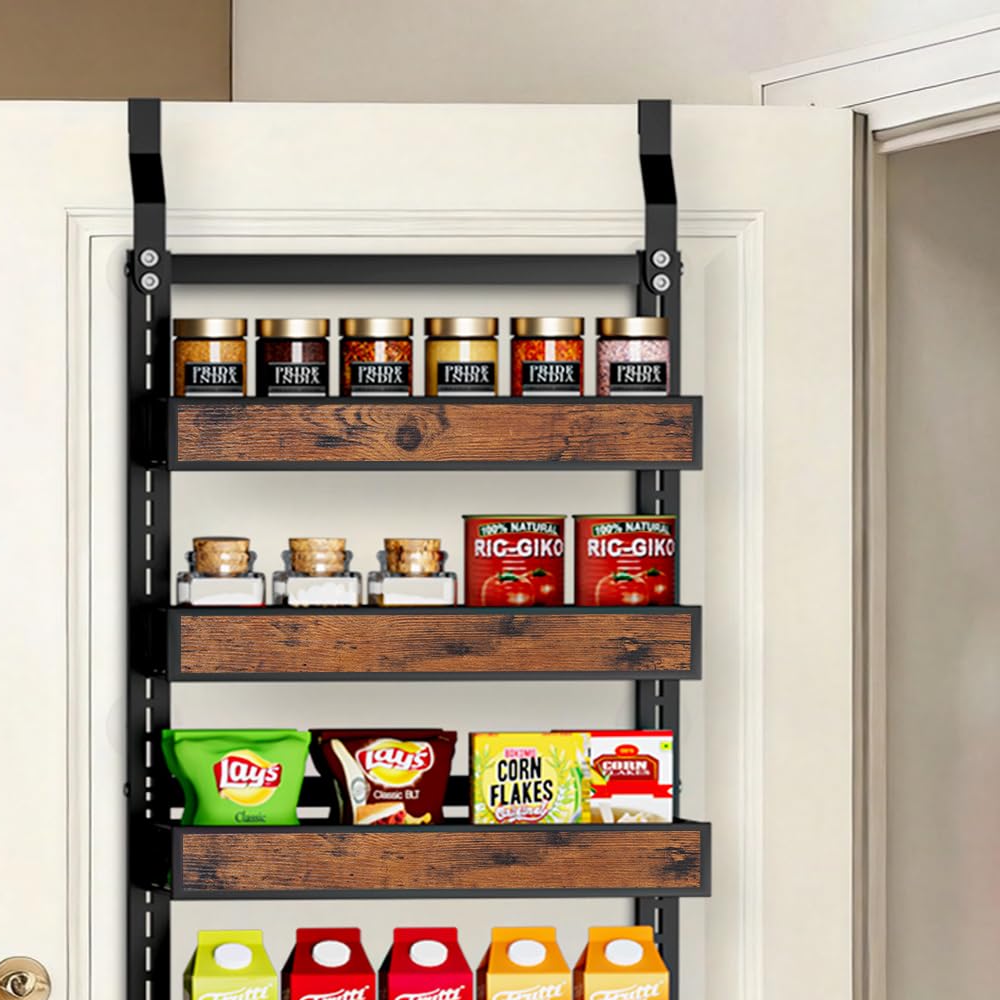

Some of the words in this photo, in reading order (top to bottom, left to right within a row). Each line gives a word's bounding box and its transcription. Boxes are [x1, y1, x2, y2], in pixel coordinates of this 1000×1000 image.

[482, 524, 508, 536] 100%
[595, 523, 622, 536] 100%
[498, 757, 542, 782] CORN
[602, 761, 648, 770] CORN
[490, 779, 553, 807] FLAKES
[234, 810, 266, 823] Classic
